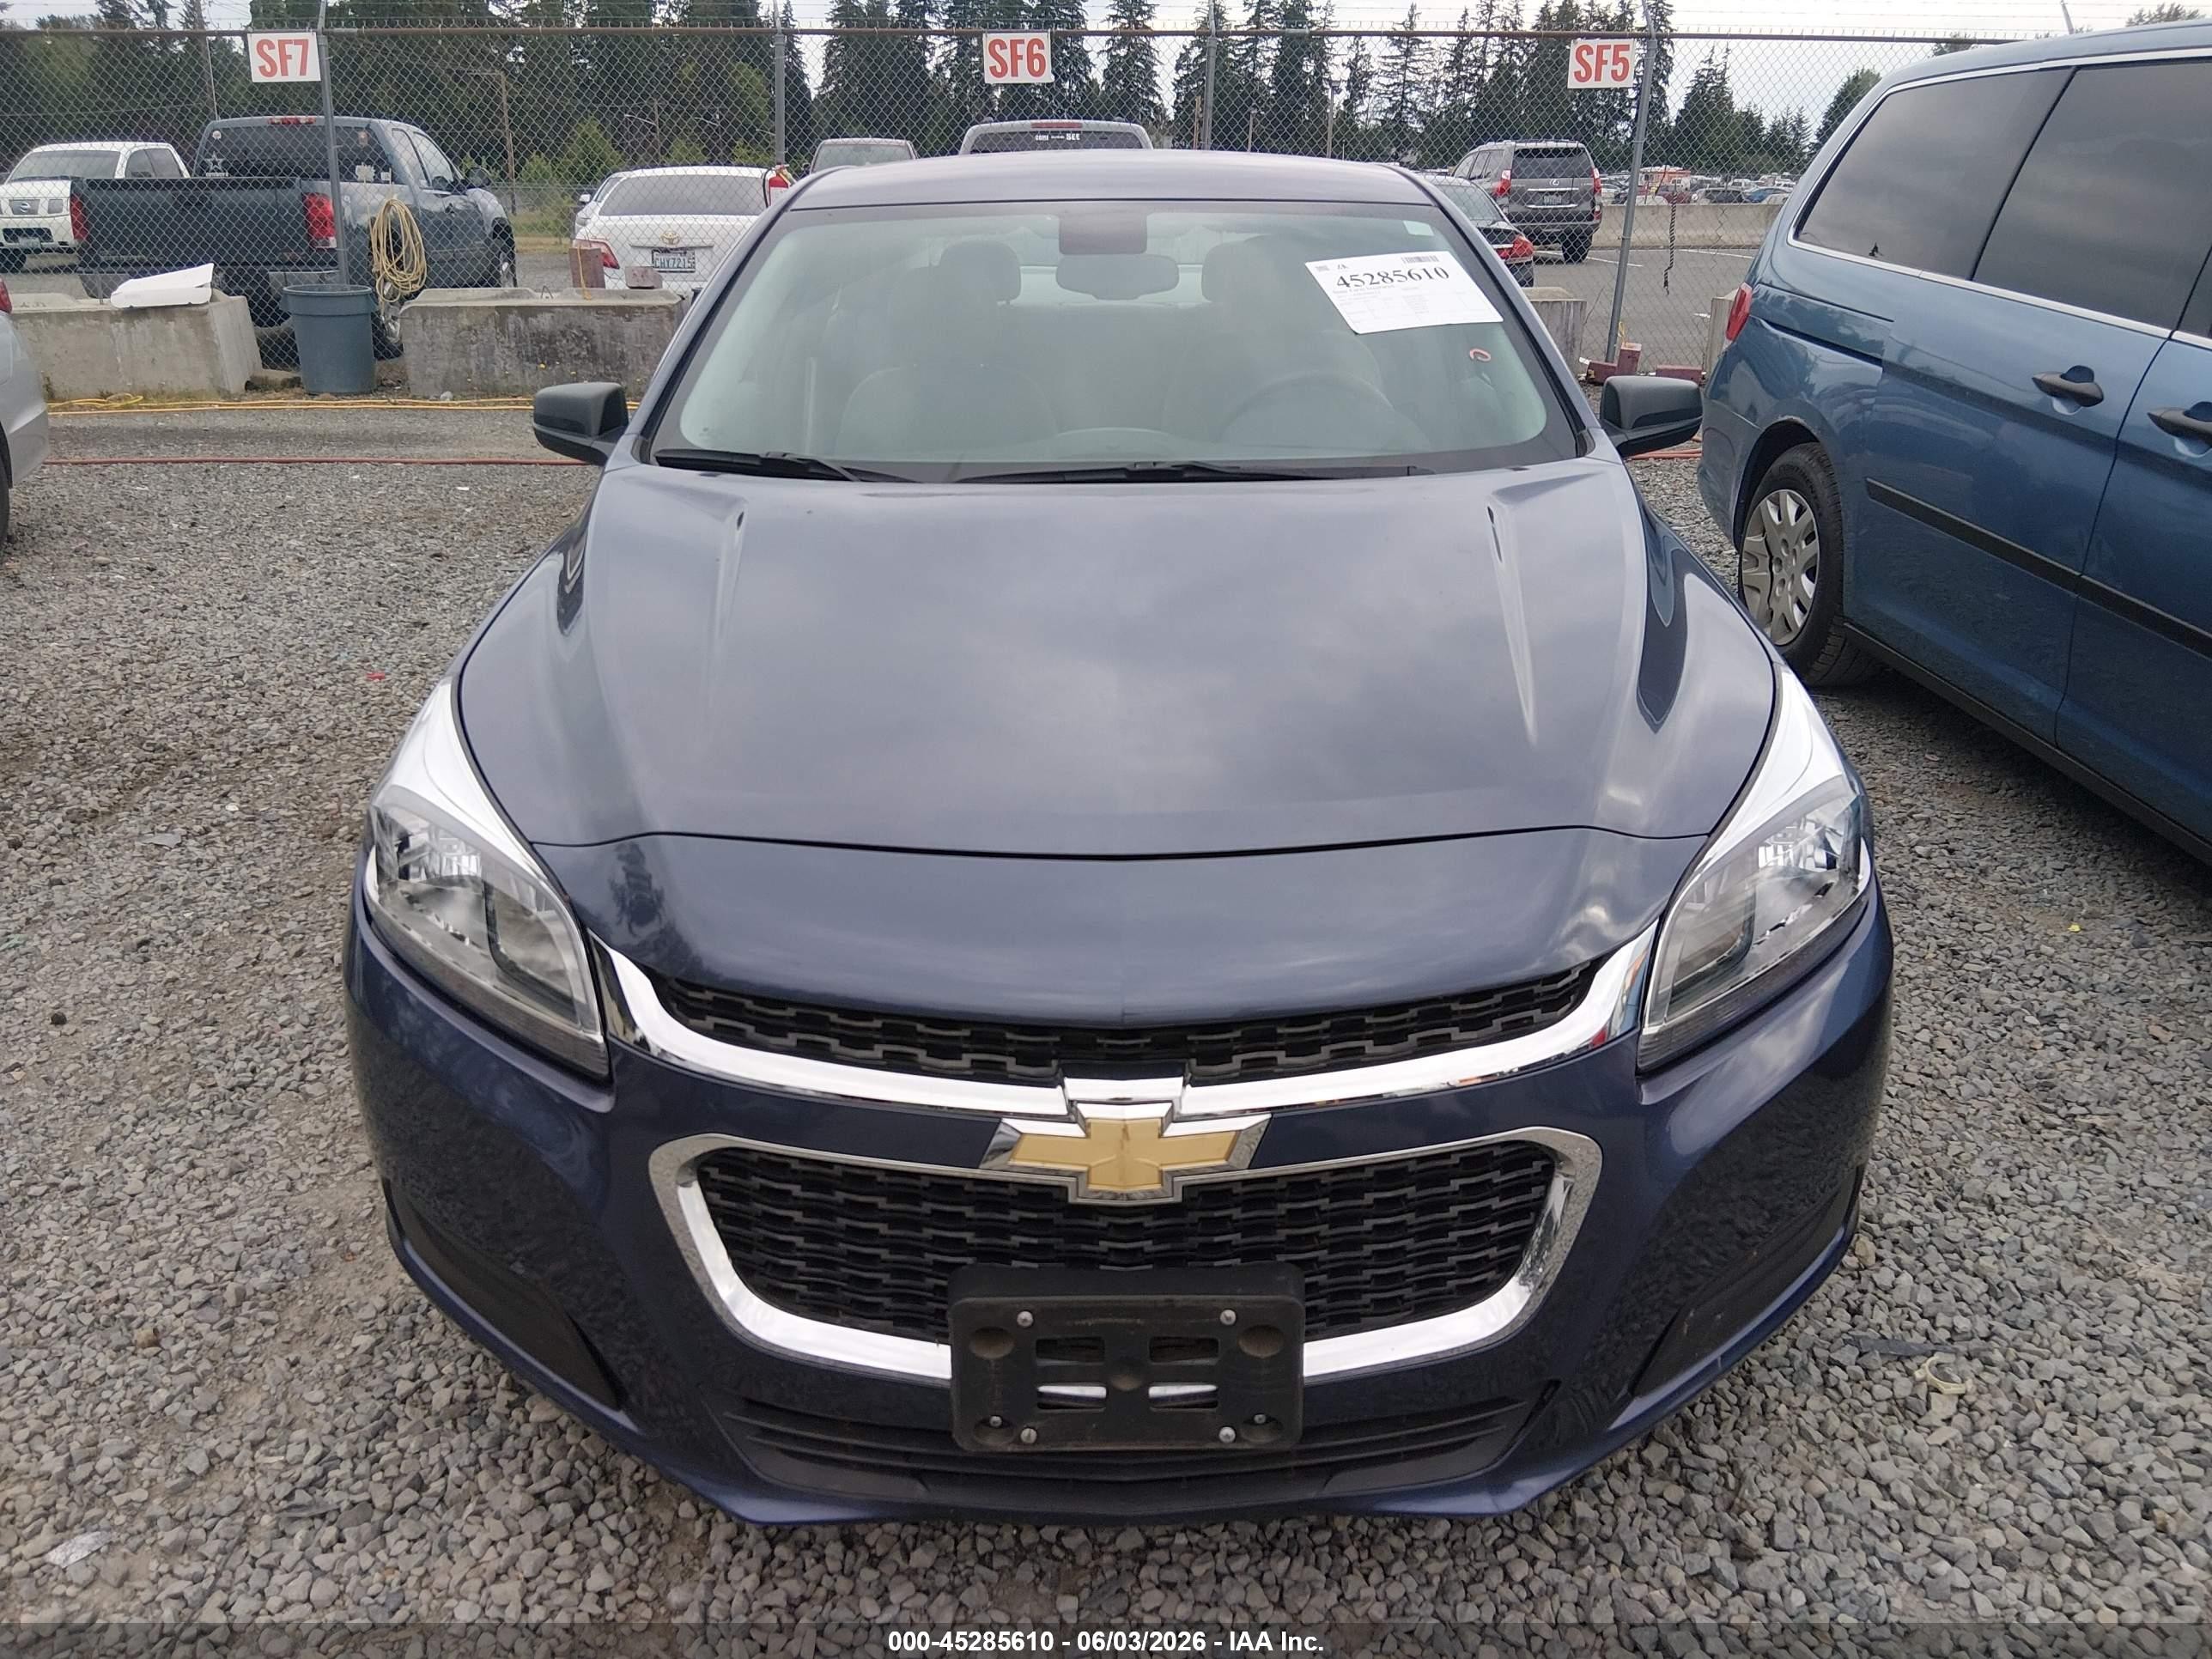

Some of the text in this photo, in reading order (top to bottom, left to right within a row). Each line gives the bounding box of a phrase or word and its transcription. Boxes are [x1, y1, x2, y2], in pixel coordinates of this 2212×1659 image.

[256, 38, 308, 77] SF7
[988, 38, 1046, 78] SF6
[1573, 44, 1630, 82] SF5
[1336, 266, 1449, 289] 45285610
